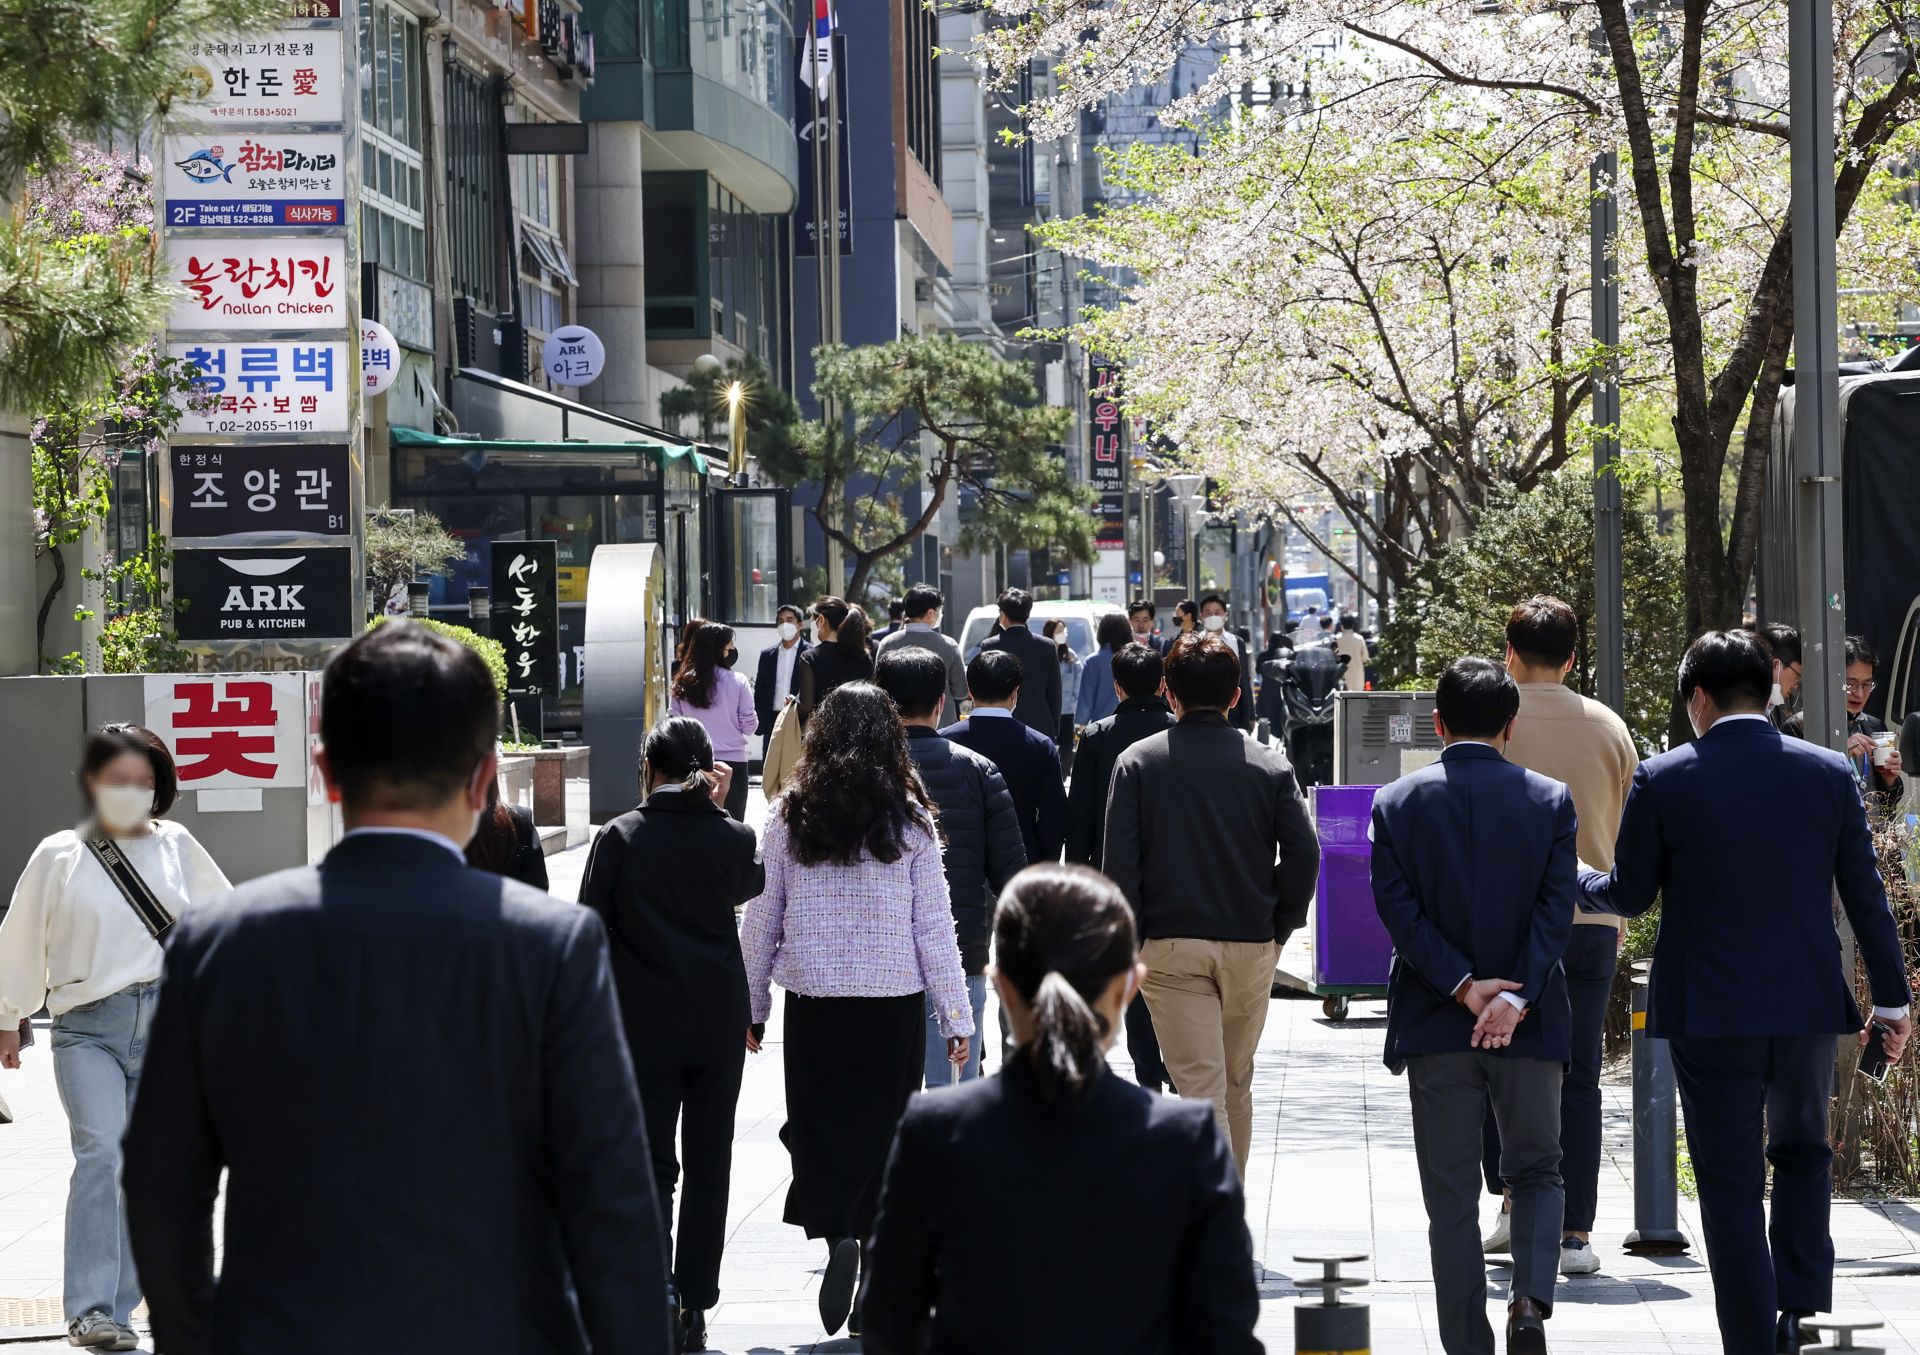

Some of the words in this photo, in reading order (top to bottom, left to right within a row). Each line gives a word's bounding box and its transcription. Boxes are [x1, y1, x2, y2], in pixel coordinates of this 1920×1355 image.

[210, 107, 244, 117] 예약문의
[238, 139, 336, 173] 참치라이더
[248, 177, 277, 190] 오늘은
[278, 177, 297, 190] 참치
[174, 207, 196, 223] 2F
[199, 204, 219, 212] Take
[220, 204, 235, 212] out
[242, 203, 273, 213] 배달가능
[290, 207, 333, 221] 식사가능
[199, 214, 232, 224] 강남역점
[180, 255, 335, 310] 놀란치킨
[277, 302, 334, 315] Chicken
[559, 345, 586, 356] ARK
[185, 347, 334, 393] 청류벽
[553, 358, 593, 380] 아크
[179, 453, 223, 466] 한정식
[190, 467, 333, 512] 조양관
[328, 514, 344, 529] B1
[220, 584, 306, 612] ARK
[220, 619, 243, 629] PUB
[245, 619, 255, 629] &
[258, 618, 306, 629] KITCHEN
[528, 686, 543, 695] 2F
[171, 681, 279, 782] 꽃
[101, 848, 119, 867] DIOR
